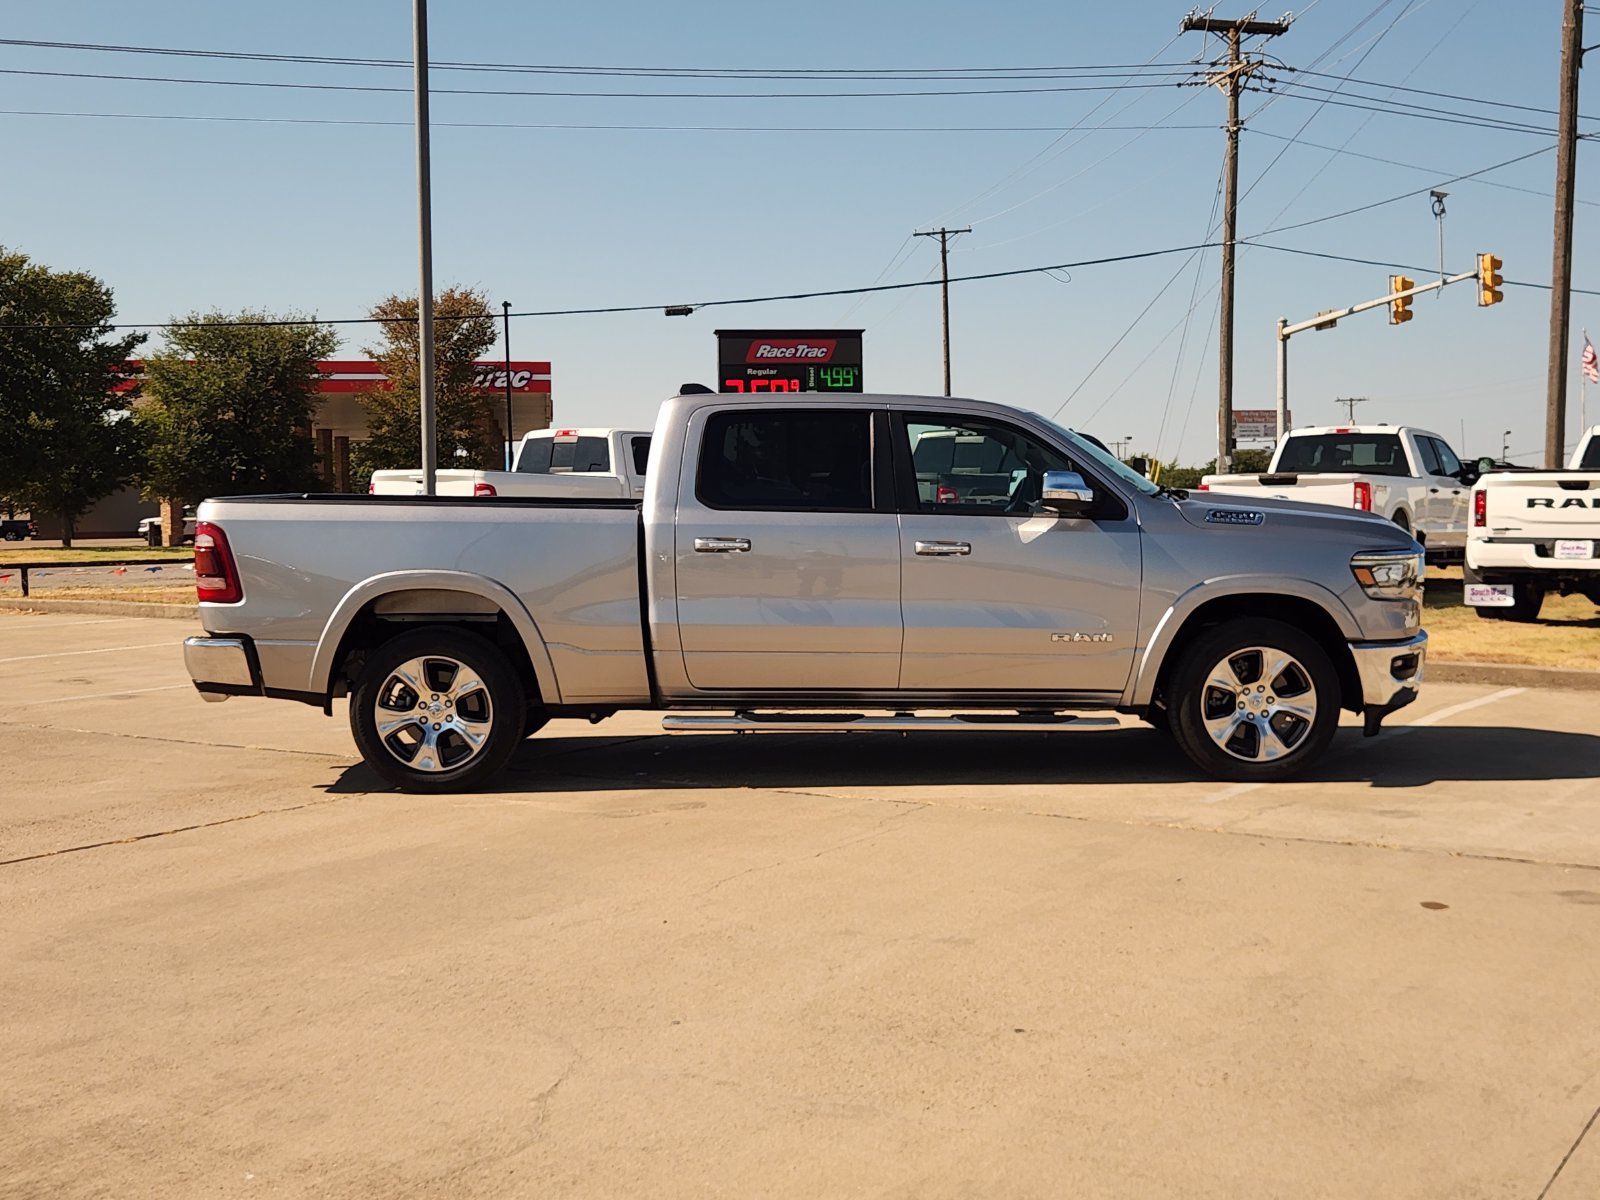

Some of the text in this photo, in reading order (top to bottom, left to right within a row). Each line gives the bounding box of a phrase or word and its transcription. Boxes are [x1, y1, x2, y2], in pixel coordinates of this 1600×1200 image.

[756, 345, 828, 358] RaceTrac
[747, 368, 778, 376] Regular
[1526, 498, 1600, 508] RA
[1051, 632, 1113, 642] RAM
